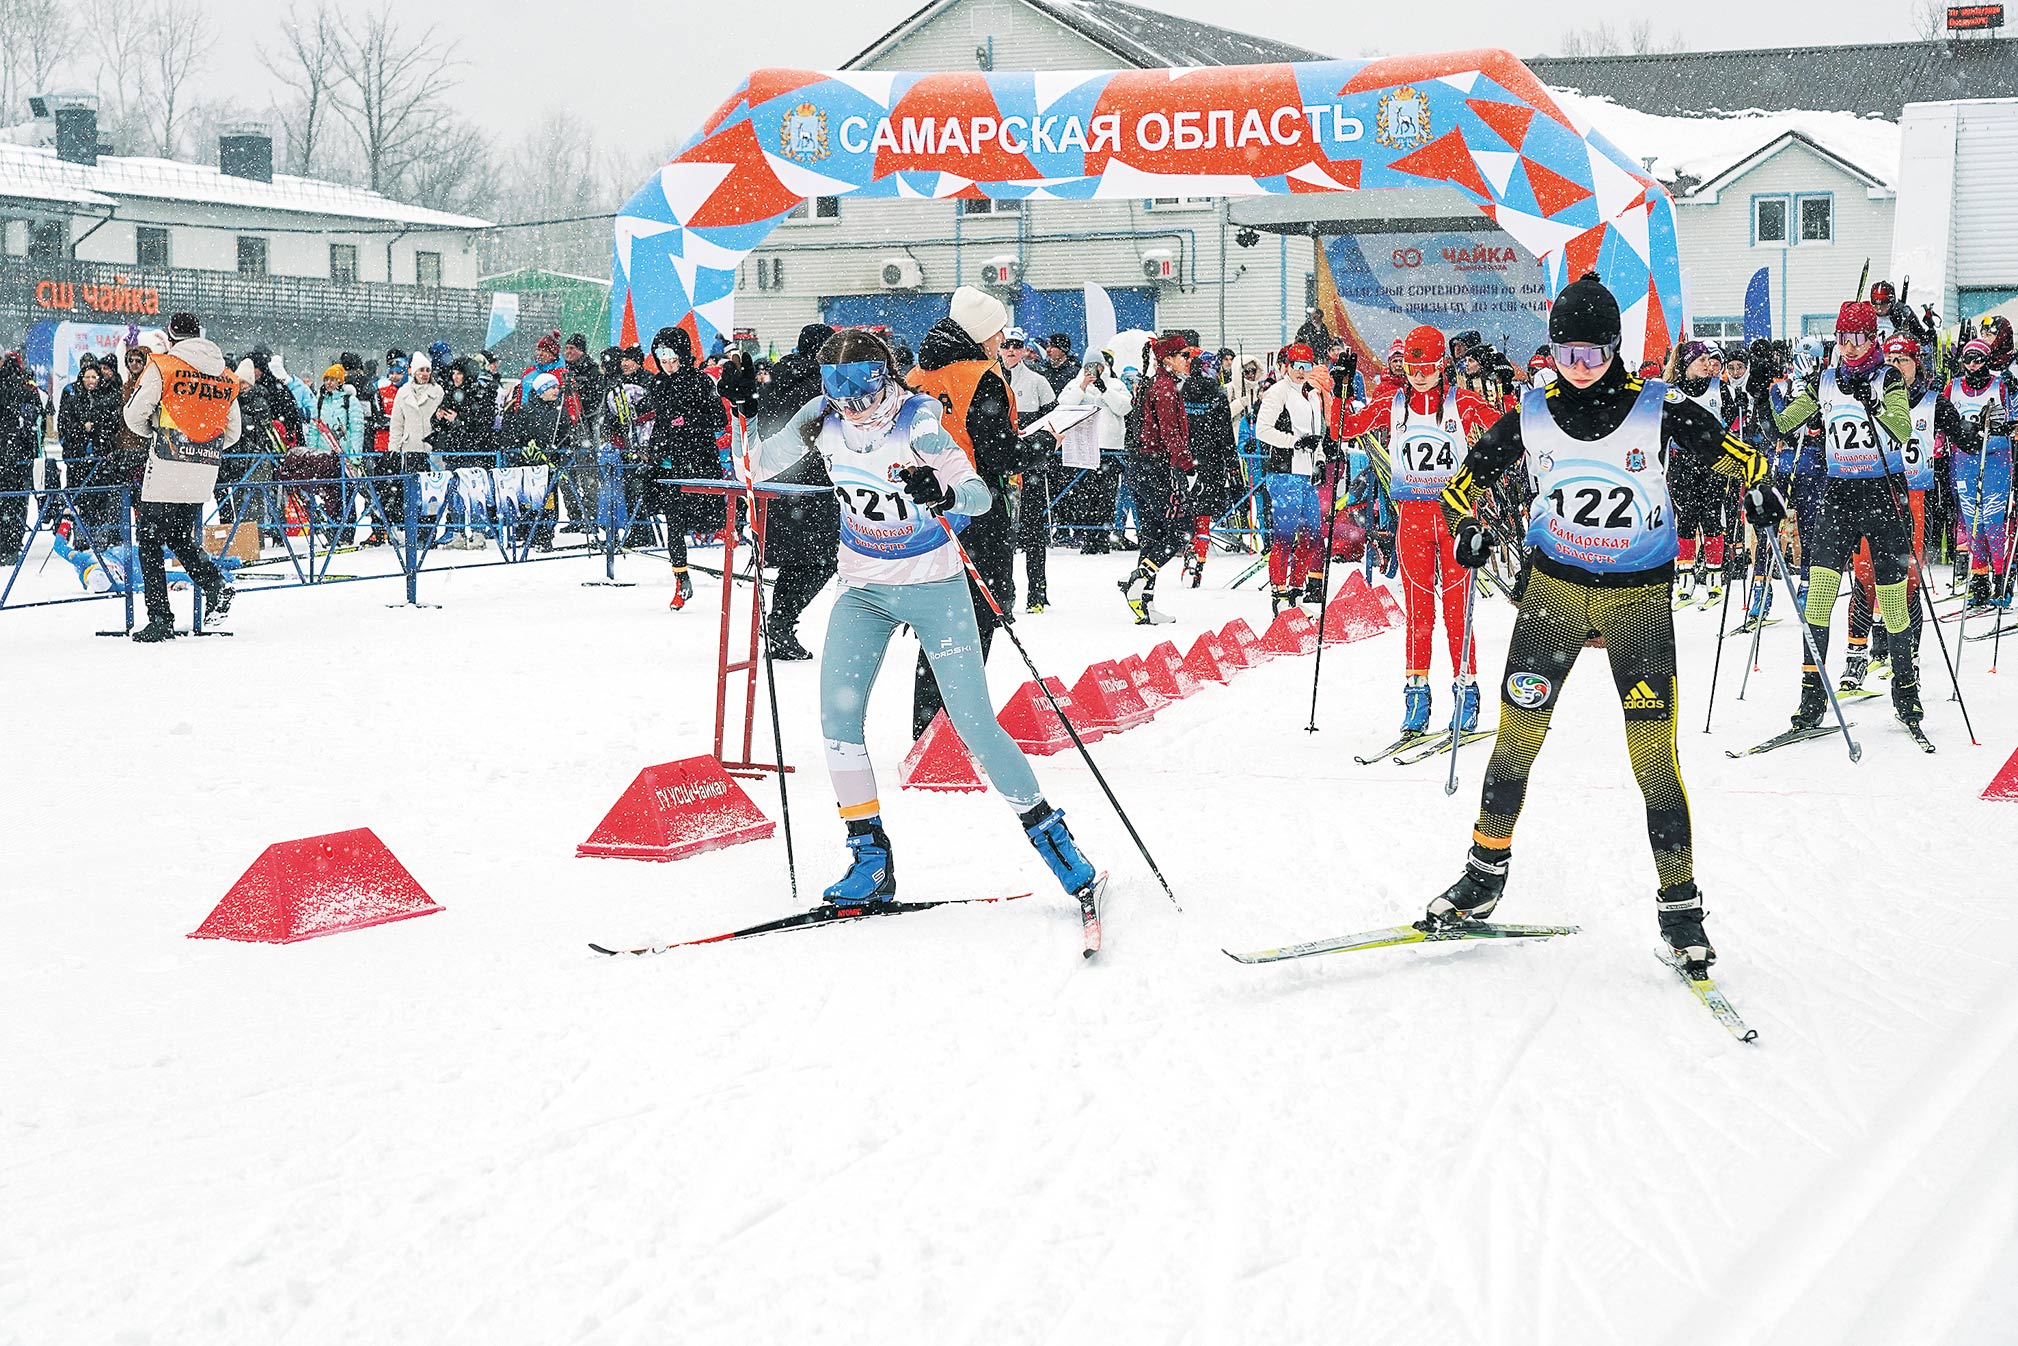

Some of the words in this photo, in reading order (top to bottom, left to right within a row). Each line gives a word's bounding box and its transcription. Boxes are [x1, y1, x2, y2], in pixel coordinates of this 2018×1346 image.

[838, 114, 1122, 155] САМАРСКАЯ
[1136, 103, 1365, 151] ОБЛАСТЬ
[1442, 243, 1517, 264] ЧАЙКА
[83, 276, 159, 315] чайка
[173, 381, 233, 401] СУДЬЯ
[1828, 421, 1876, 450] 123
[1402, 441, 1454, 472] 124
[835, 486, 908, 522] 121
[1549, 486, 1634, 529] 122
[847, 516, 914, 539] Самарская
[1645, 505, 1664, 531] 12
[1550, 518, 1631, 550] Самарская
[930, 644, 972, 661] NORDSKI
[1623, 698, 1666, 709] adidas
[837, 907, 863, 917] ATOMIC
